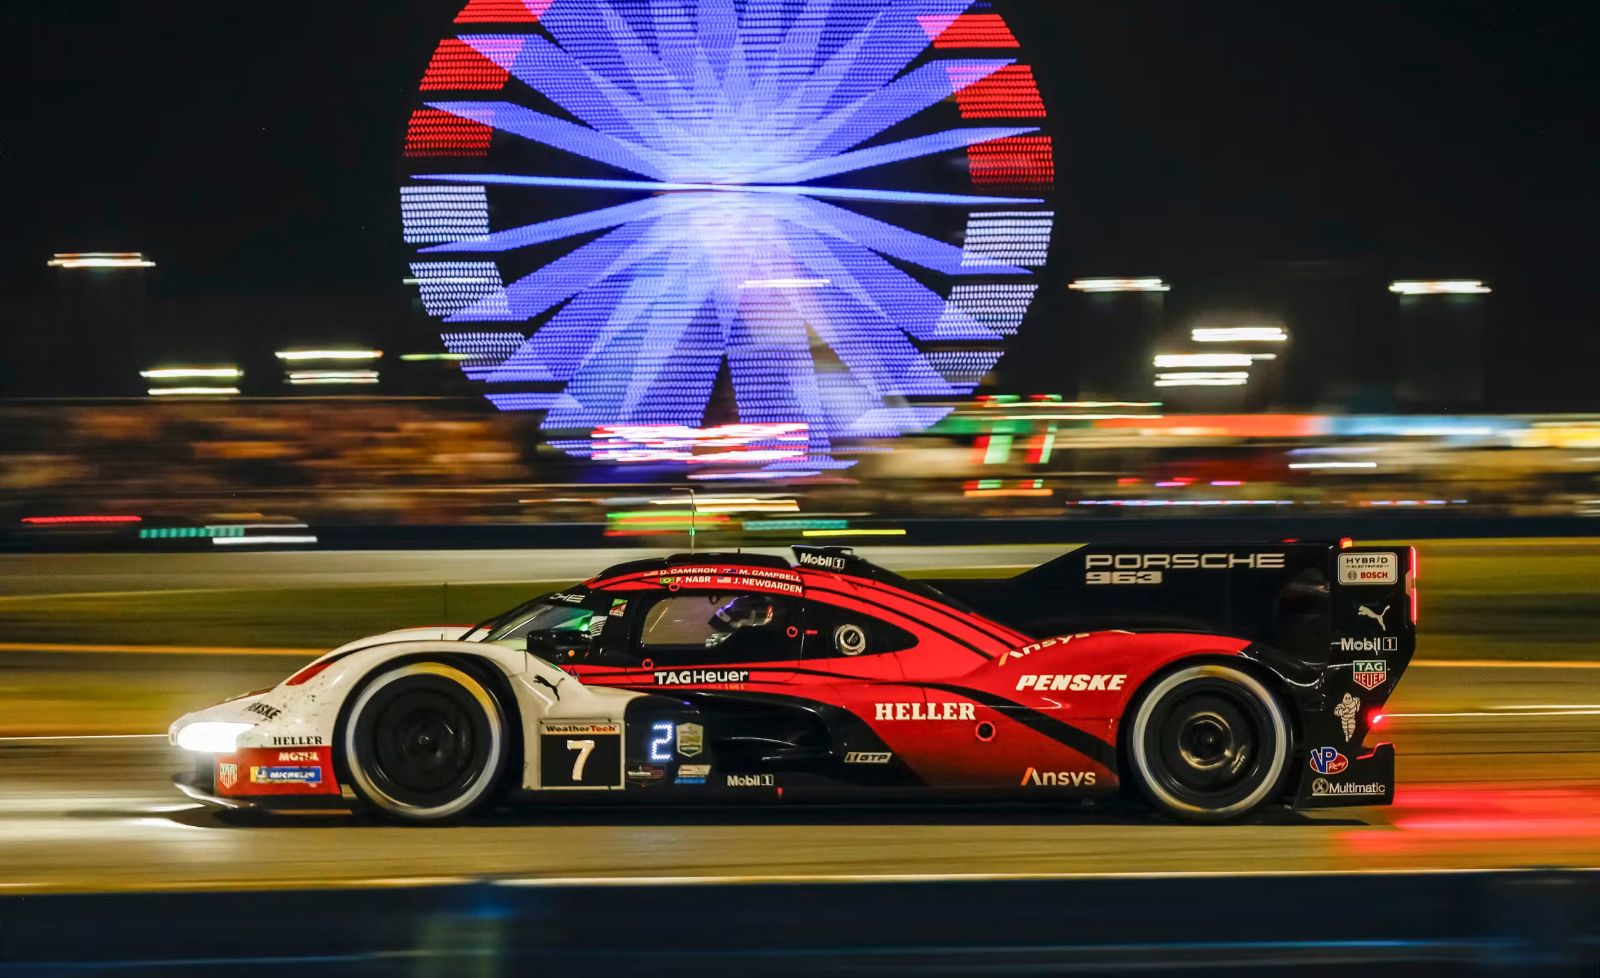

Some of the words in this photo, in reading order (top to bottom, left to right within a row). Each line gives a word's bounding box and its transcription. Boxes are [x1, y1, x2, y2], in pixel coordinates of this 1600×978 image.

[800, 552, 832, 568] Mobil
[1085, 553, 1285, 569] PORSCHE
[1346, 556, 1388, 564] HYBRID
[752, 570, 802, 583] CAMPBELL
[1085, 571, 1163, 584] 963
[1360, 571, 1388, 579] BOSCH
[676, 576, 684, 584] F.
[685, 575, 711, 583] NASR
[742, 577, 803, 594] NEWGARDEN
[1341, 637, 1381, 651] Mobil
[1356, 663, 1384, 672] TAG
[1015, 674, 1128, 691] PENSKE
[1355, 672, 1385, 688] HEUER
[875, 702, 977, 721] HELLER
[273, 735, 323, 746] HELLER
[651, 724, 673, 760] 2
[567, 740, 595, 781] 7
[860, 753, 889, 762] GTP
[1311, 747, 1338, 774] VP
[727, 775, 760, 787] Mobil
[1020, 766, 1097, 787] Ansys
[1329, 782, 1386, 793] Multimatic
